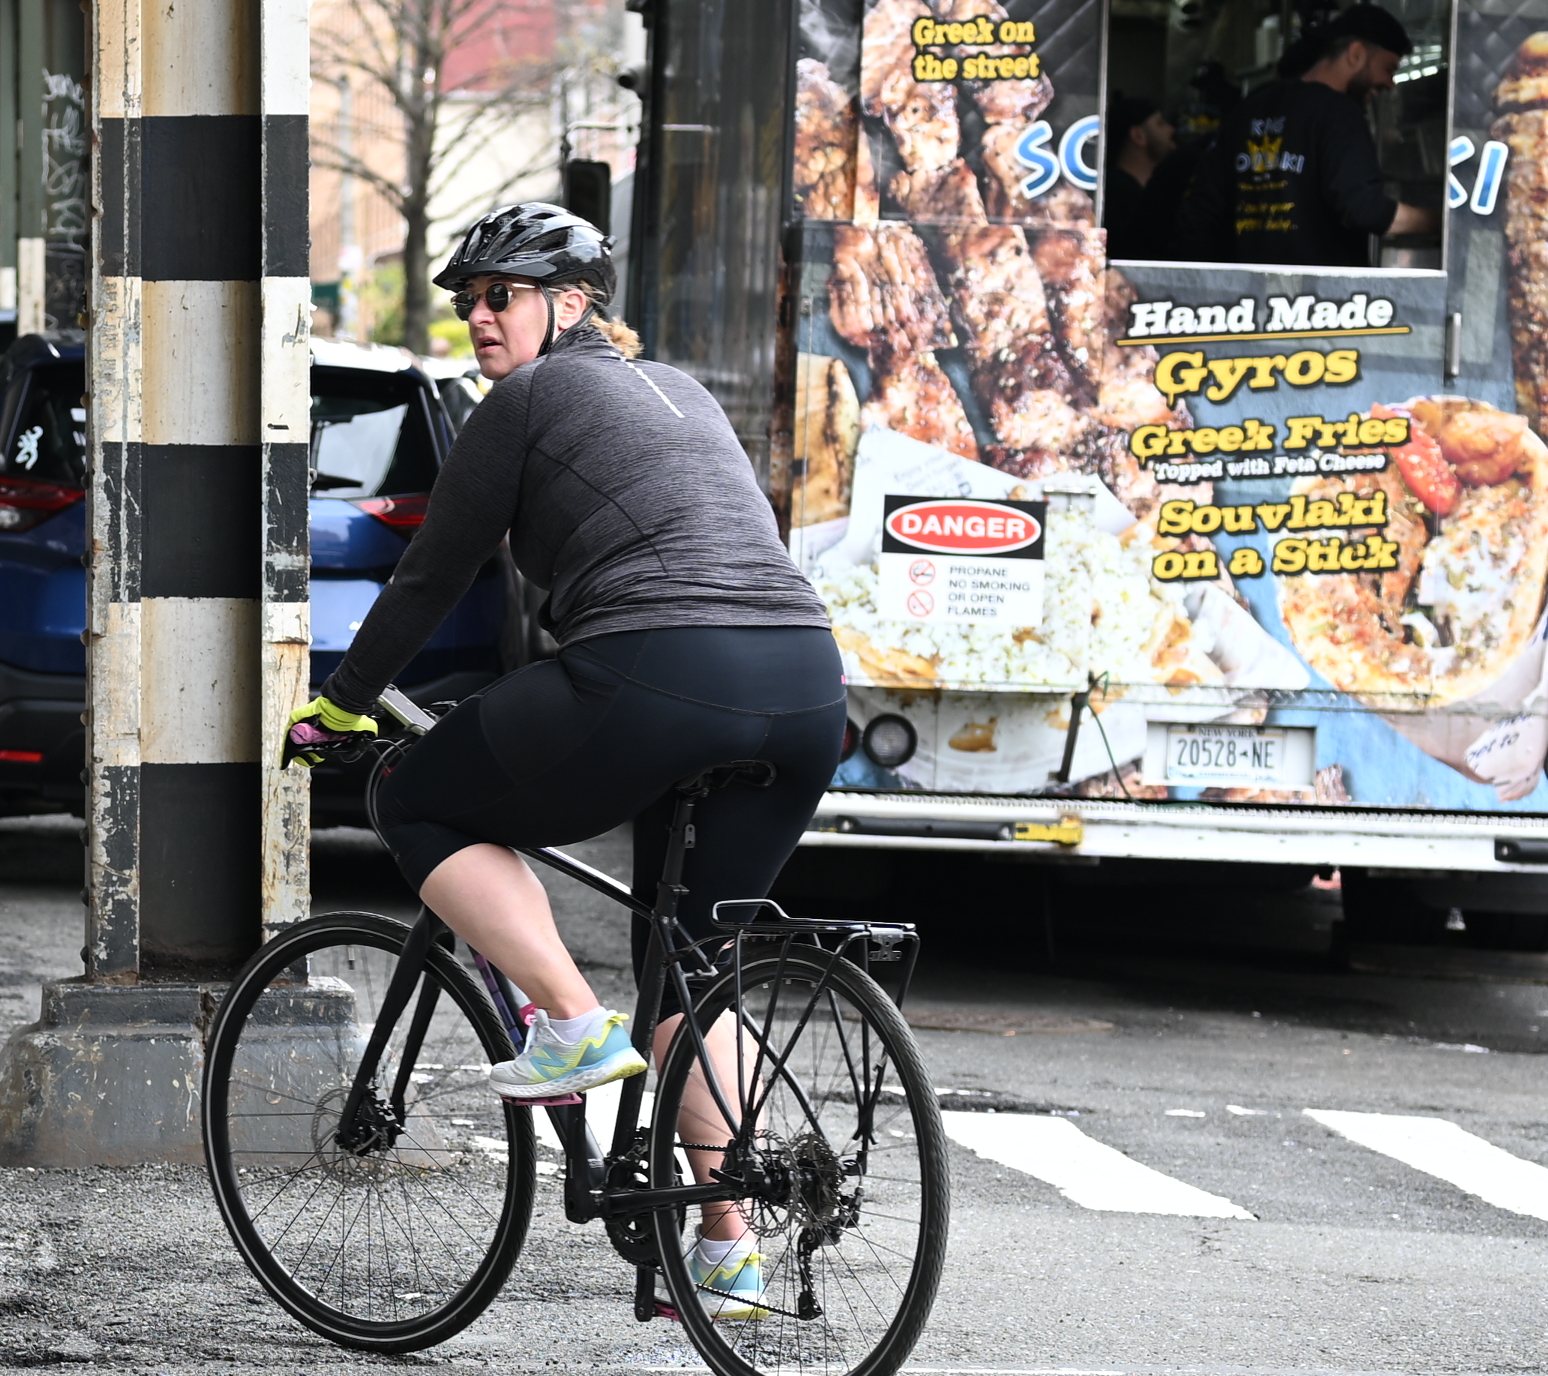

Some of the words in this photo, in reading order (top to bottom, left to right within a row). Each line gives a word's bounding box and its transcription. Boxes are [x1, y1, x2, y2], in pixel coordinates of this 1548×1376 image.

[913, 18, 995, 45] Greek
[999, 20, 1036, 43] on
[914, 55, 958, 80] the
[962, 52, 1041, 79] street
[1128, 298, 1256, 337] Hand
[1265, 294, 1394, 333] Made
[1155, 350, 1358, 404] Gyros
[1131, 420, 1275, 460] Greek
[1283, 414, 1411, 449] Fries
[1156, 460, 1223, 481] Topped
[1227, 457, 1270, 476] with
[1274, 456, 1317, 474] Feta
[1319, 453, 1386, 471] Cheese
[901, 513, 1026, 539] DANGER
[1158, 491, 1387, 535] Souvlaki
[949, 565, 1009, 577] PROPANE
[1153, 550, 1219, 580] on
[1229, 547, 1264, 575] a
[1273, 535, 1399, 573] Stick
[948, 592, 966, 602] OR
[970, 593, 1005, 603] OPEN
[949, 579, 967, 589] NO
[971, 579, 1031, 591] SMOKING
[947, 605, 997, 616] FLAMES
[1198, 728, 1223, 736] NEW
[1227, 728, 1255, 737] YORK
